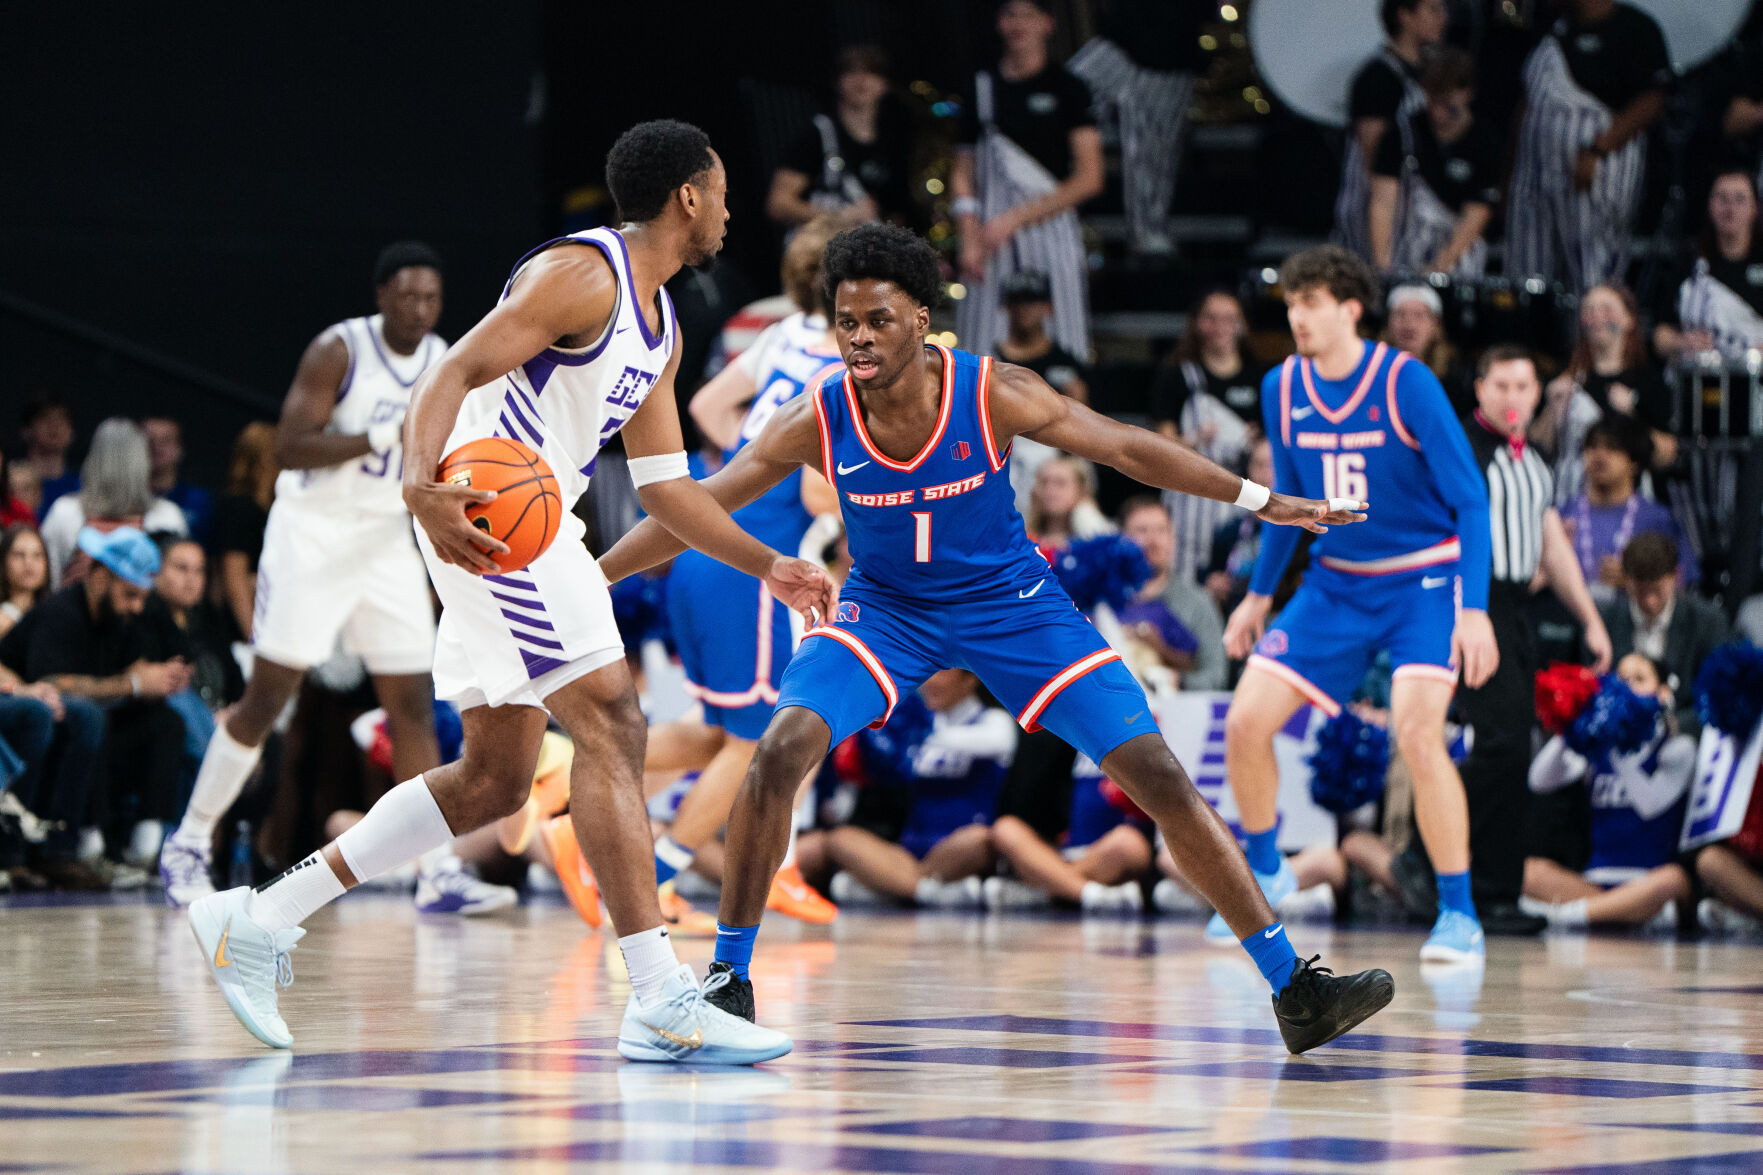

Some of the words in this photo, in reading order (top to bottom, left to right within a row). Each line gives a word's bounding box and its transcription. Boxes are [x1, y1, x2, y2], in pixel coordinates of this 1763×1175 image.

[605, 365, 659, 411] GC
[845, 489, 915, 508] BOISE
[920, 470, 987, 501] STATE
[1320, 452, 1369, 502] 16
[910, 511, 932, 563] 1
